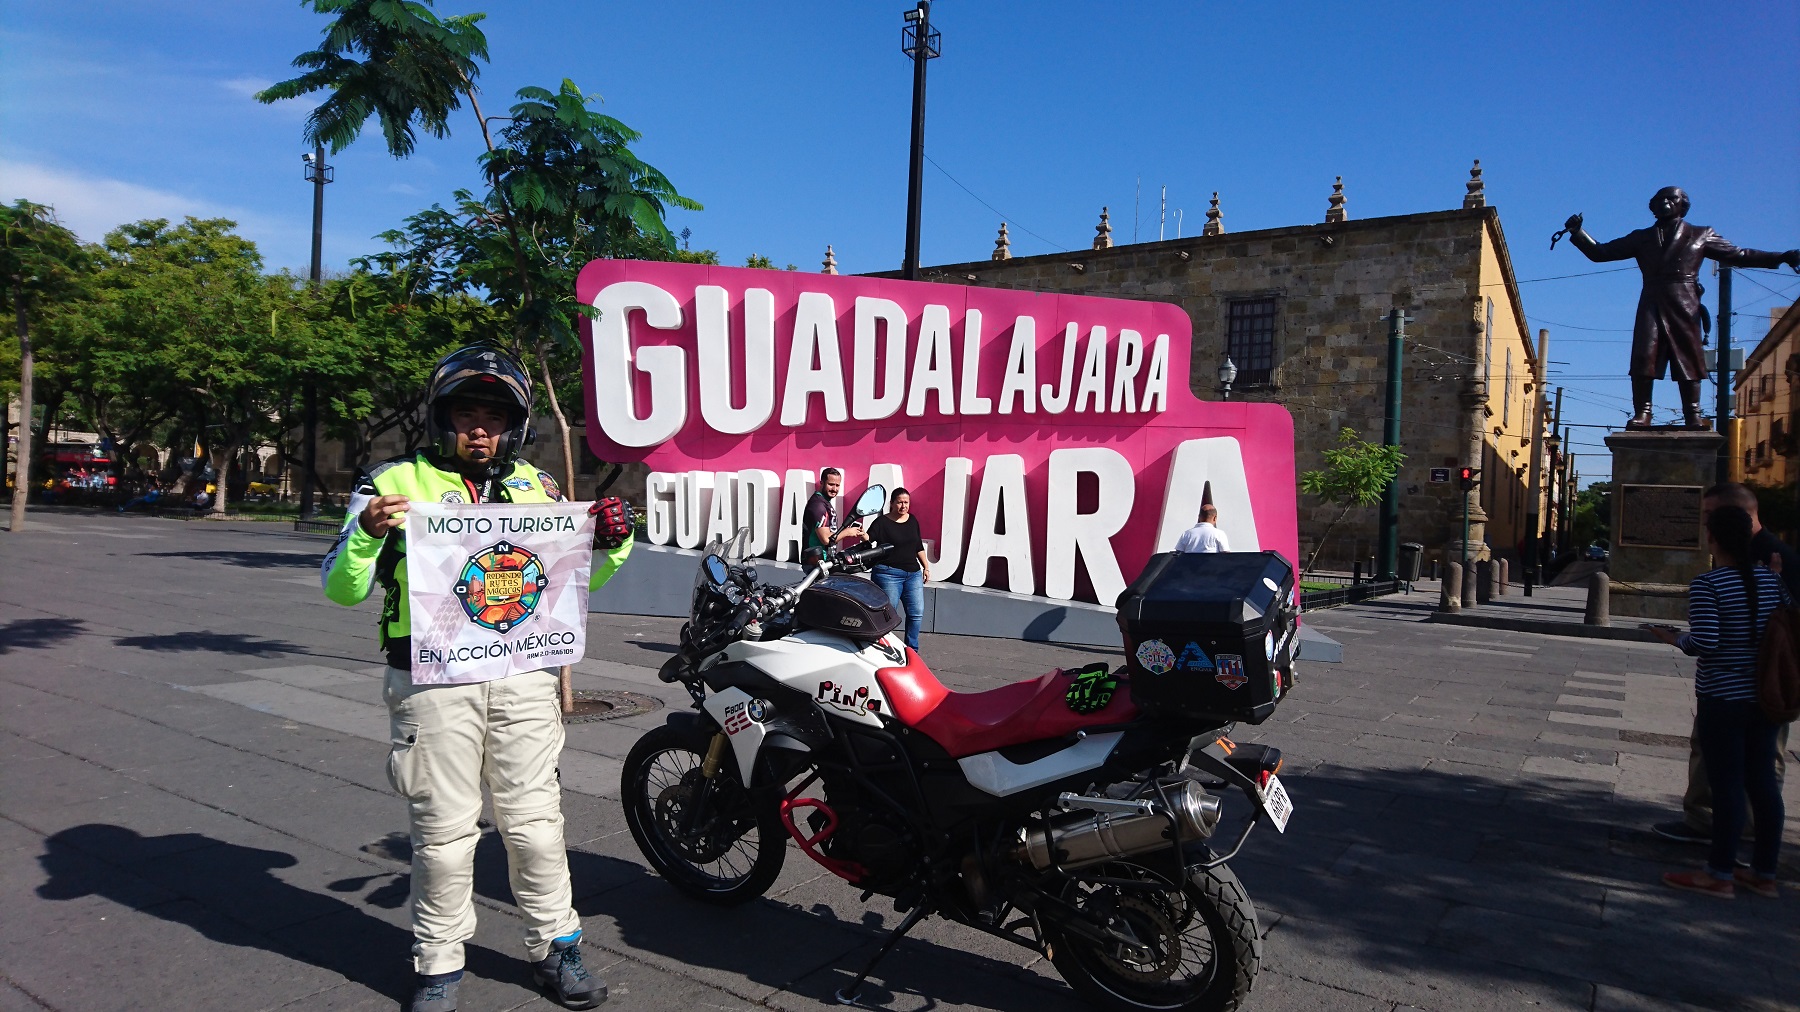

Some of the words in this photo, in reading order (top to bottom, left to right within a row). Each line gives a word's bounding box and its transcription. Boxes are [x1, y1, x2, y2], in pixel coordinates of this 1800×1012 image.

[592, 281, 1169, 448] GUADALAJARA
[427, 516, 493, 534] MOTO
[499, 515, 576, 534] TURISTA
[646, 436, 1262, 605] GUADAJARA
[498, 544, 509, 552] N
[456, 585, 467, 593] O
[537, 579, 546, 587] E
[499, 622, 509, 630] S
[419, 649, 442, 664] EN
[446, 640, 513, 664] ACCIÓN
[515, 632, 575, 652] MÉXICO
[724, 701, 744, 718] F800
[724, 710, 753, 736] GS
